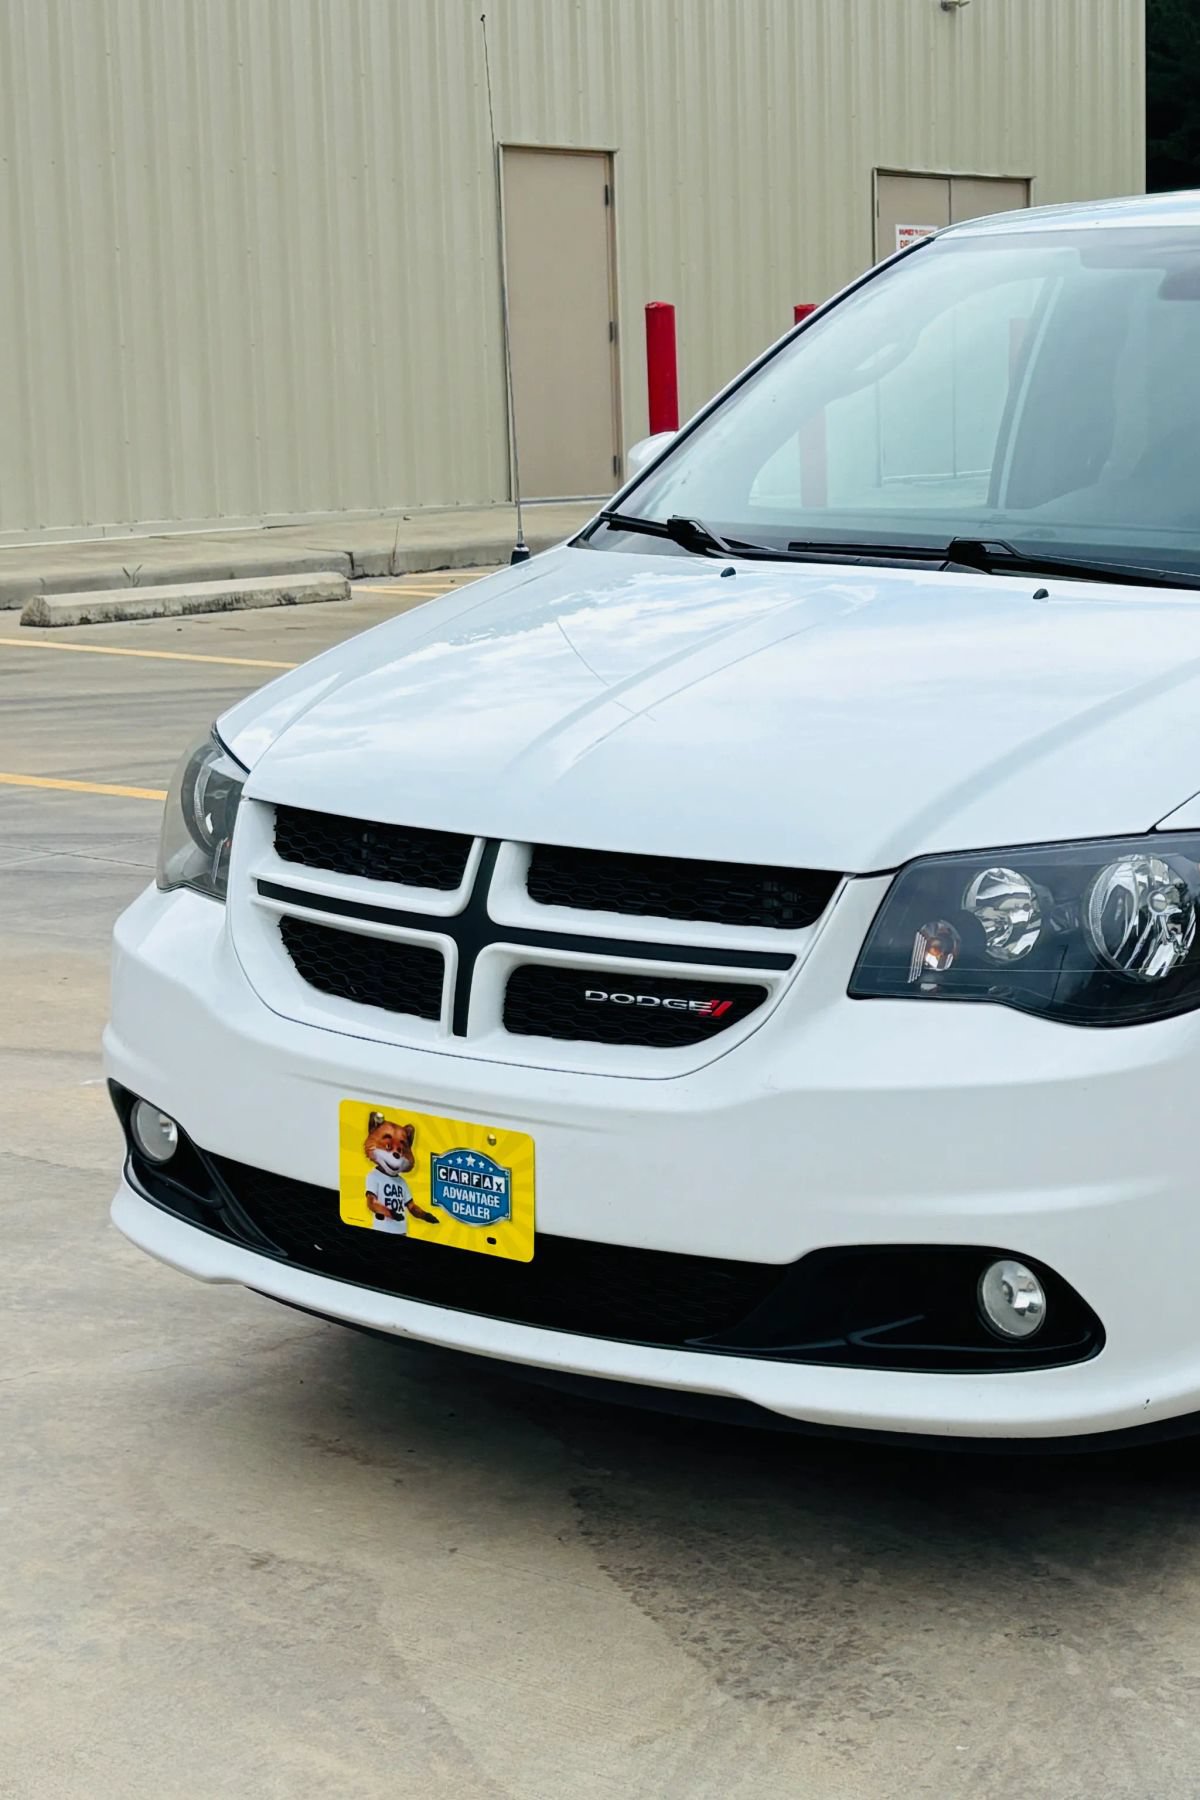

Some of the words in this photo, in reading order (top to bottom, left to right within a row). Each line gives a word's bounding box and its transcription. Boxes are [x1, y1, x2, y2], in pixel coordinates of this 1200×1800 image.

[585, 990, 713, 1013] DODGE
[383, 1183, 404, 1198] CAR
[438, 1167, 503, 1193] CARFAX
[384, 1197, 405, 1212] FOX
[442, 1185, 501, 1208] ADVANTAGE
[452, 1201, 490, 1220] DEALER
